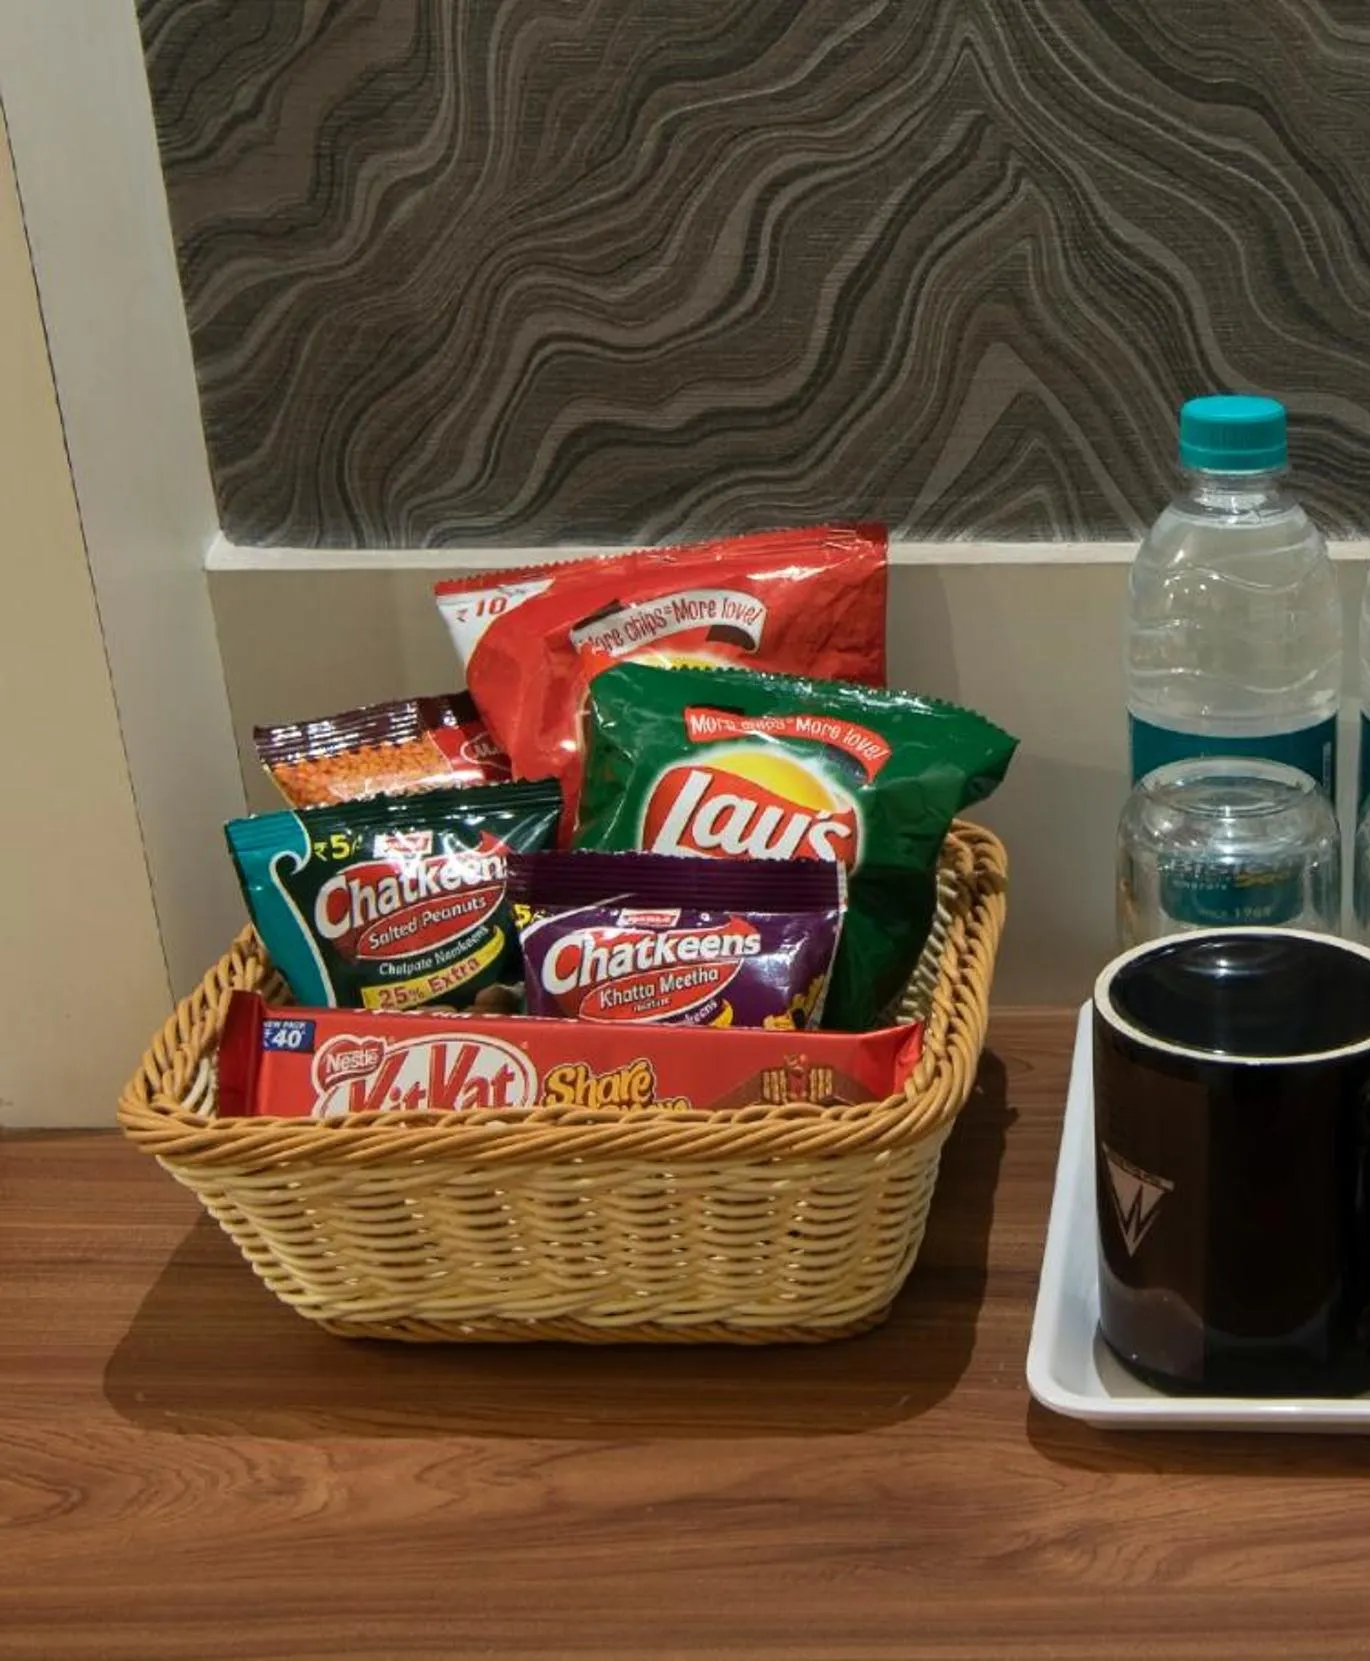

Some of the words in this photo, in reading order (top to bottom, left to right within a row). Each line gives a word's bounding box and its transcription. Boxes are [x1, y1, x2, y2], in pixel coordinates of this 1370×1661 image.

[476, 596, 507, 617] 10
[722, 597, 760, 626] love!
[689, 714, 736, 735] More
[843, 729, 887, 761] love!
[369, 917, 418, 949] Salted
[422, 896, 486, 926] Peanuts
[378, 986, 425, 1009] 25%
[428, 958, 482, 993] Extra
[541, 931, 762, 996] Chatkeens
[599, 983, 655, 1010] Khatta
[658, 967, 719, 996] Meetha
[545, 1061, 652, 1108] Share
